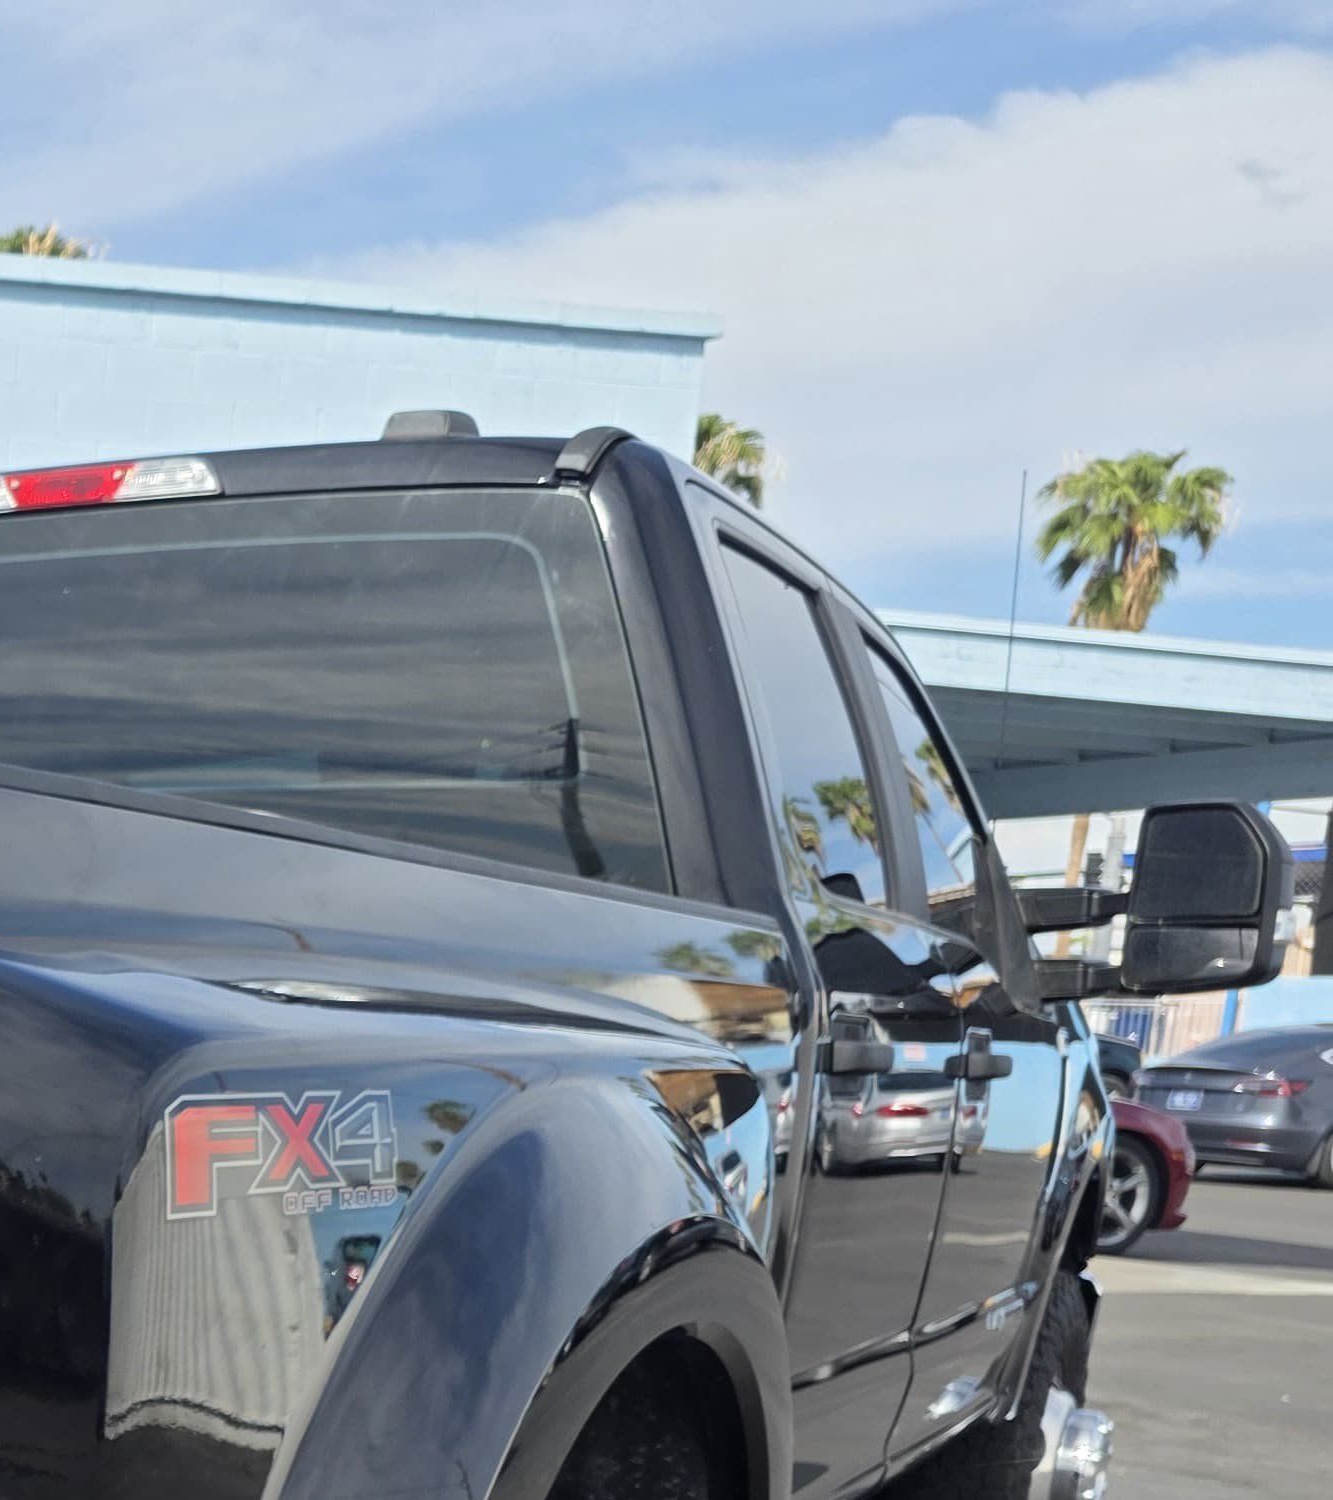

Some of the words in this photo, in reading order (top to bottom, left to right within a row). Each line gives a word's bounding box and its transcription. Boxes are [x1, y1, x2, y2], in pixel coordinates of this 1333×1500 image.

[164, 1090, 397, 1220] FX4
[283, 1190, 332, 1215] OFF
[339, 1185, 397, 1210] ROAD
